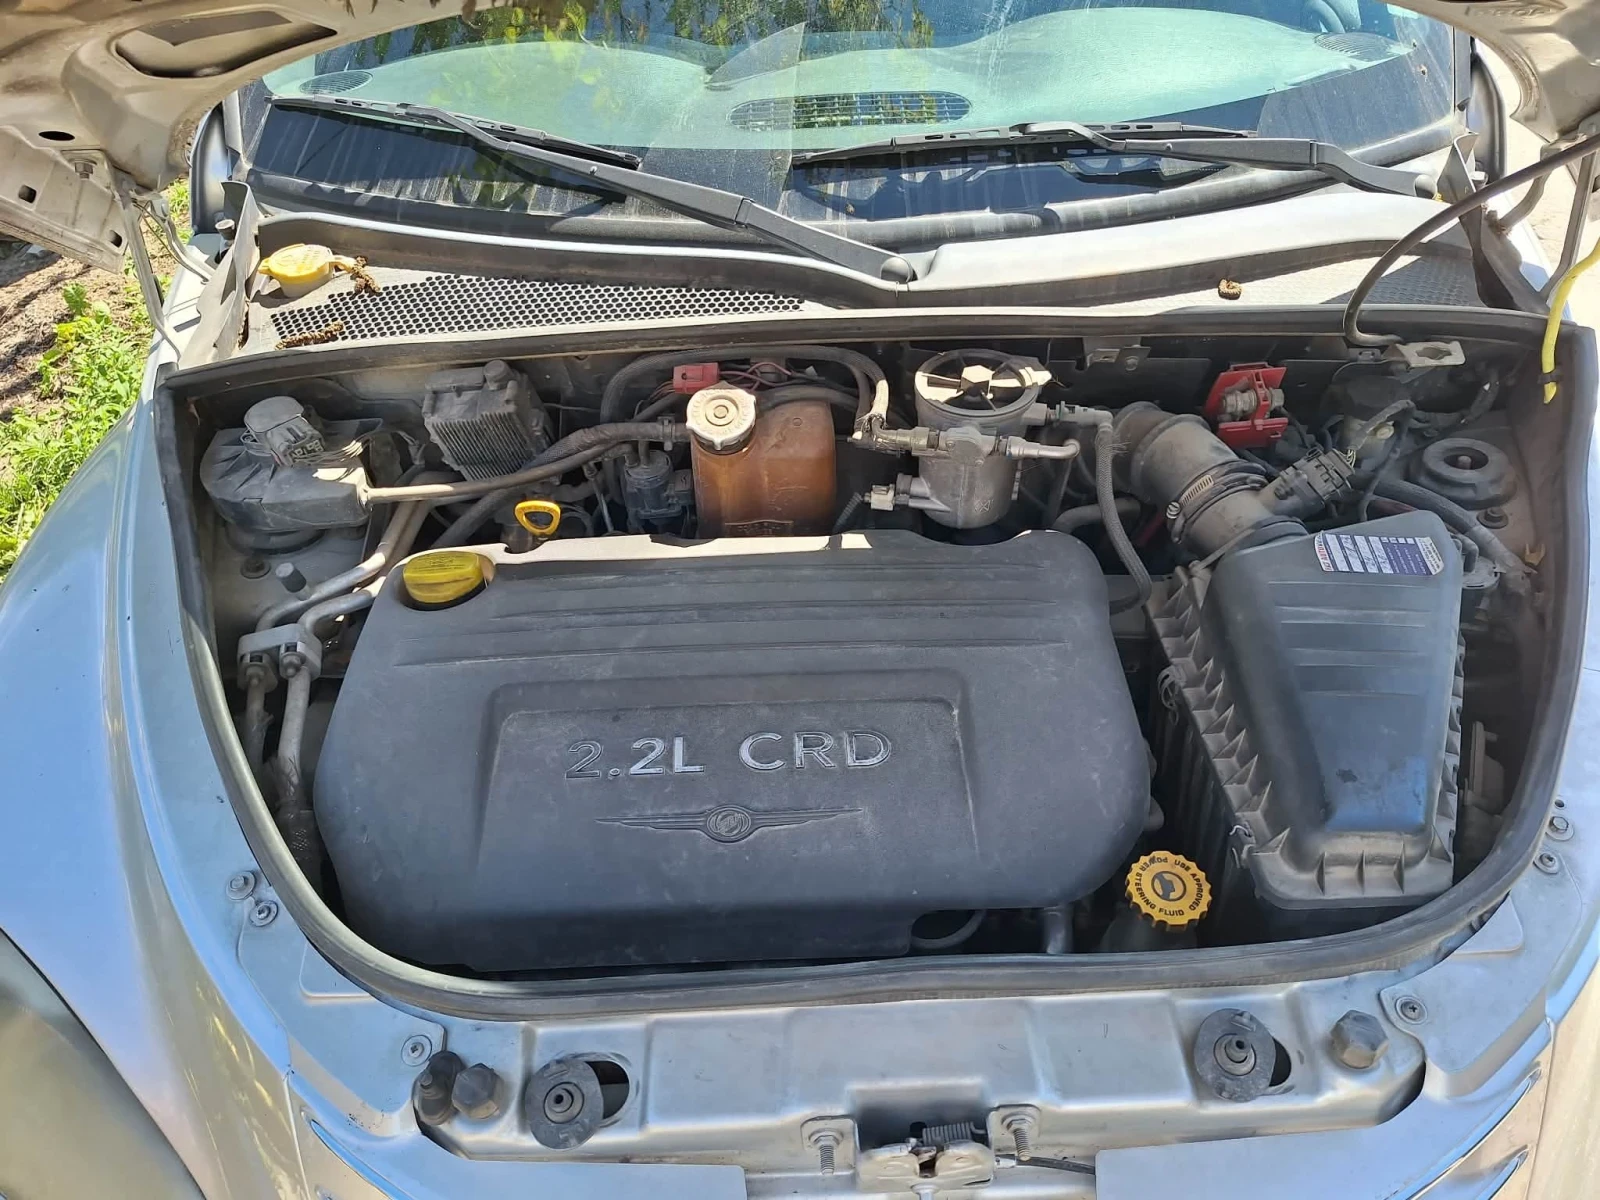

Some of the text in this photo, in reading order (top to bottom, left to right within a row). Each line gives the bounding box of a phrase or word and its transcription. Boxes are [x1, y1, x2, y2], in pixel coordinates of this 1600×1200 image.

[565, 729, 892, 779] 2.2L CRD
[1135, 856, 1185, 916] POWER STEERING FLUID
[1174, 859, 1204, 911] USE APPROVED
